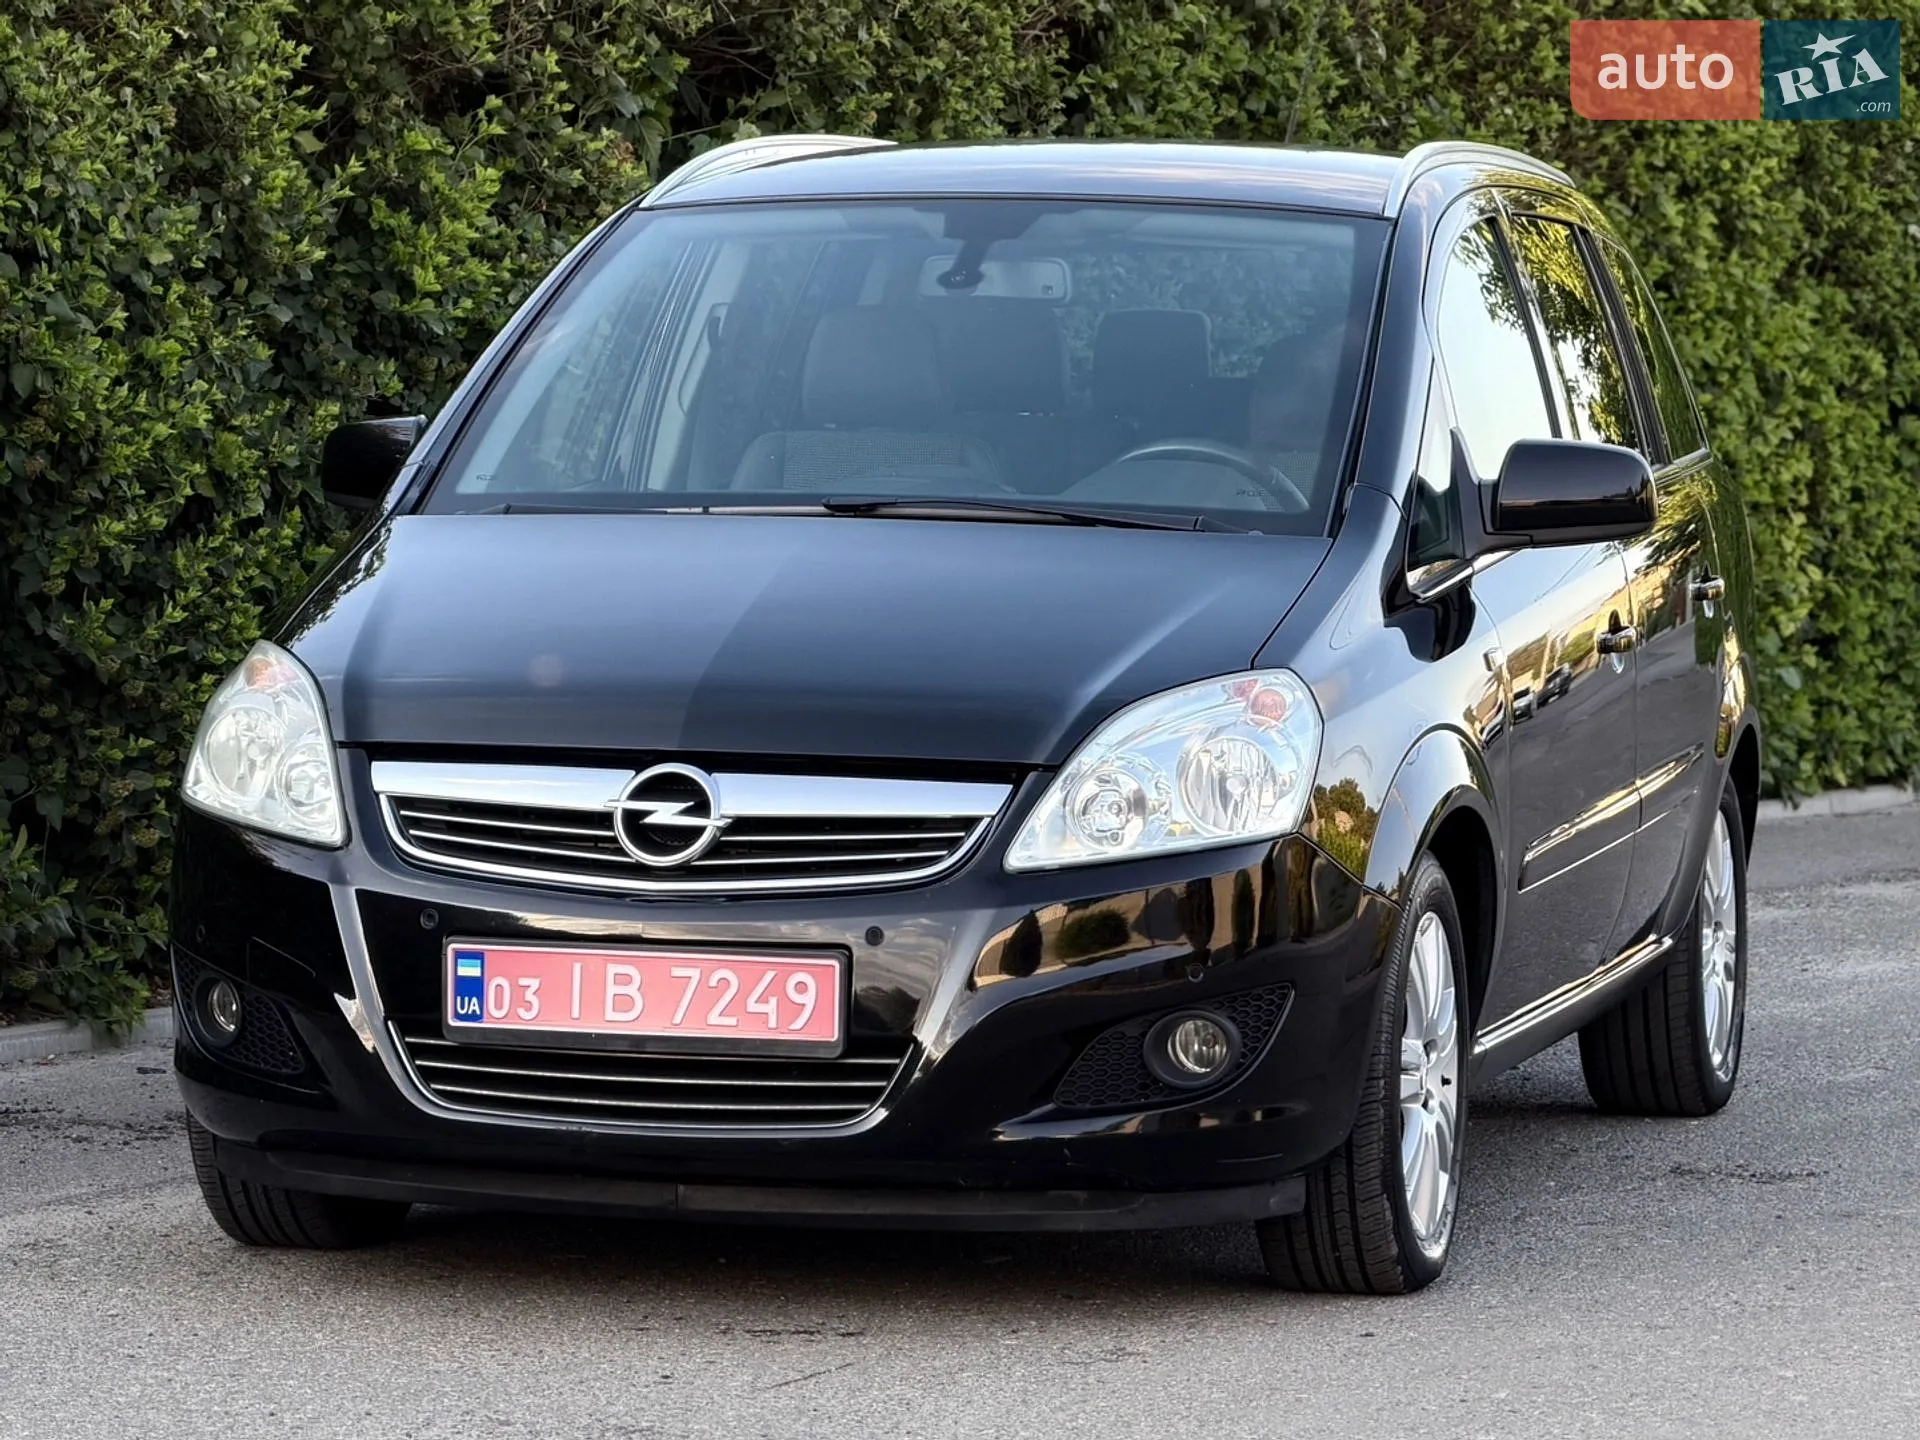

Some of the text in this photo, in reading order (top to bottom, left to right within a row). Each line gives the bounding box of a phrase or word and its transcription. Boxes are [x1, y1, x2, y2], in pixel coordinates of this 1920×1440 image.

[456, 997, 481, 1015] UA
[487, 976, 542, 1020] 03
[670, 967, 817, 1030] 7249
